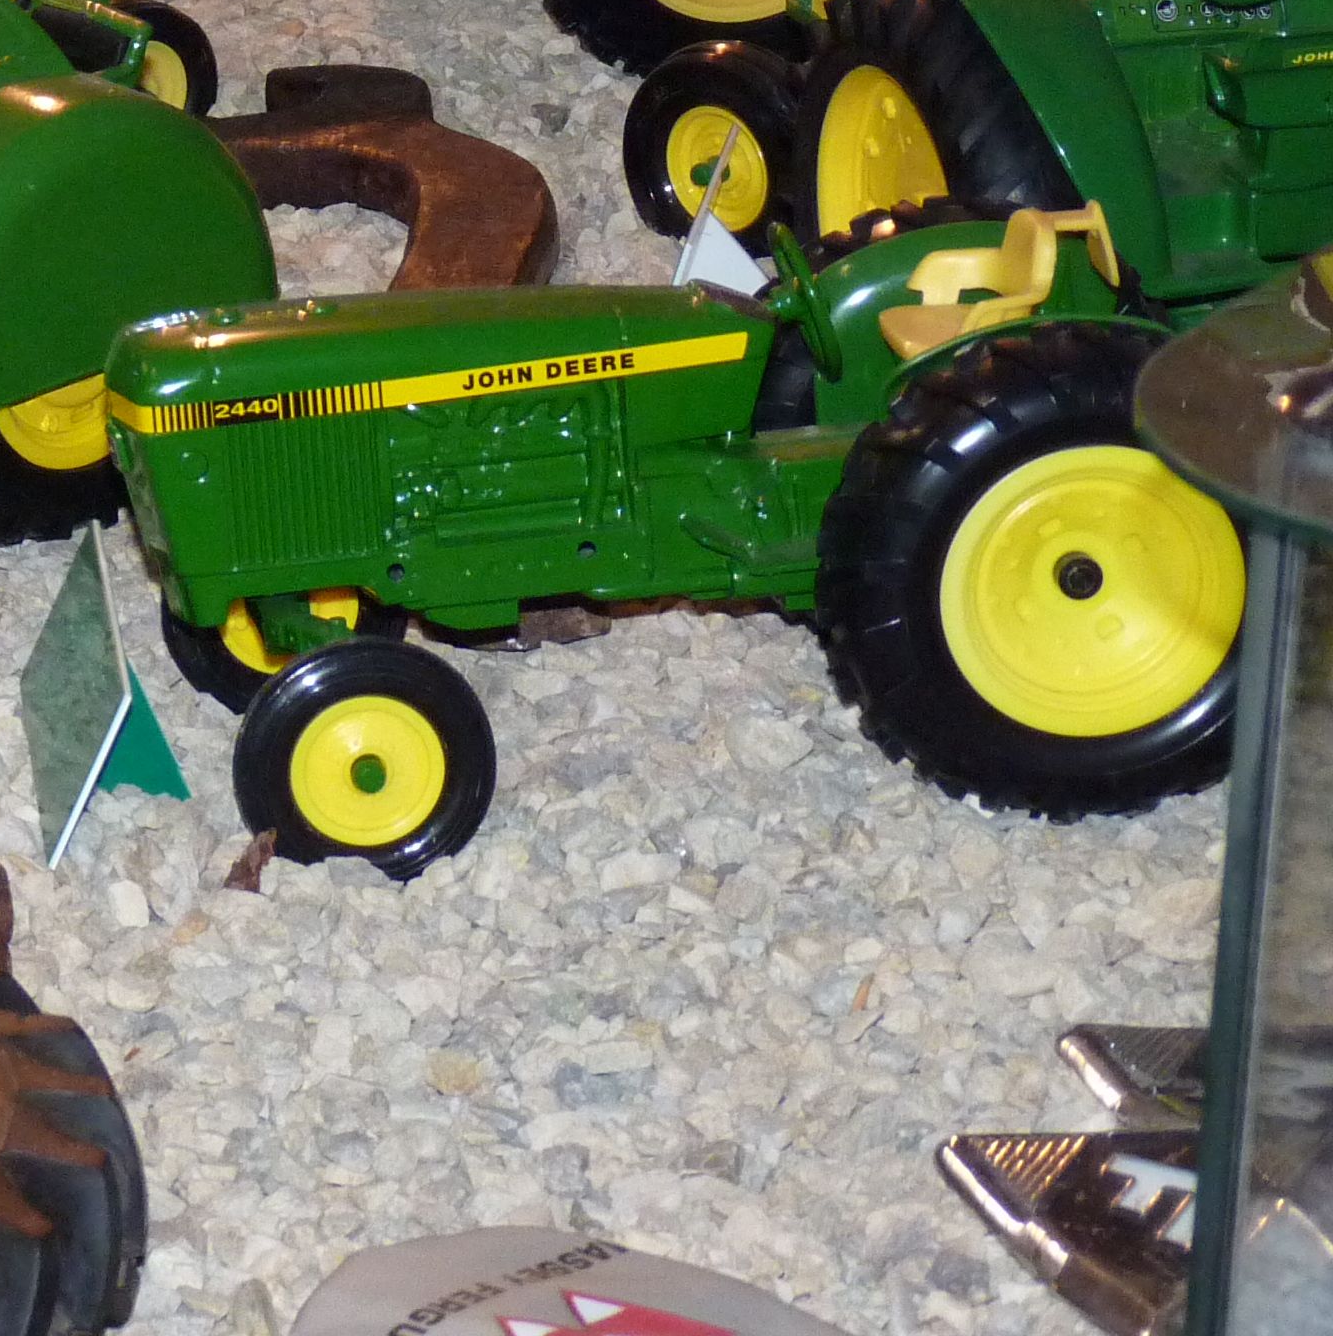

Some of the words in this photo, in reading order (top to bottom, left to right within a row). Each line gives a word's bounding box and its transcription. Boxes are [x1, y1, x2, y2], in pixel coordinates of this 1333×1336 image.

[461, 365, 533, 392] JOHN
[545, 352, 636, 379] DEERE
[213, 397, 279, 420] 2440
